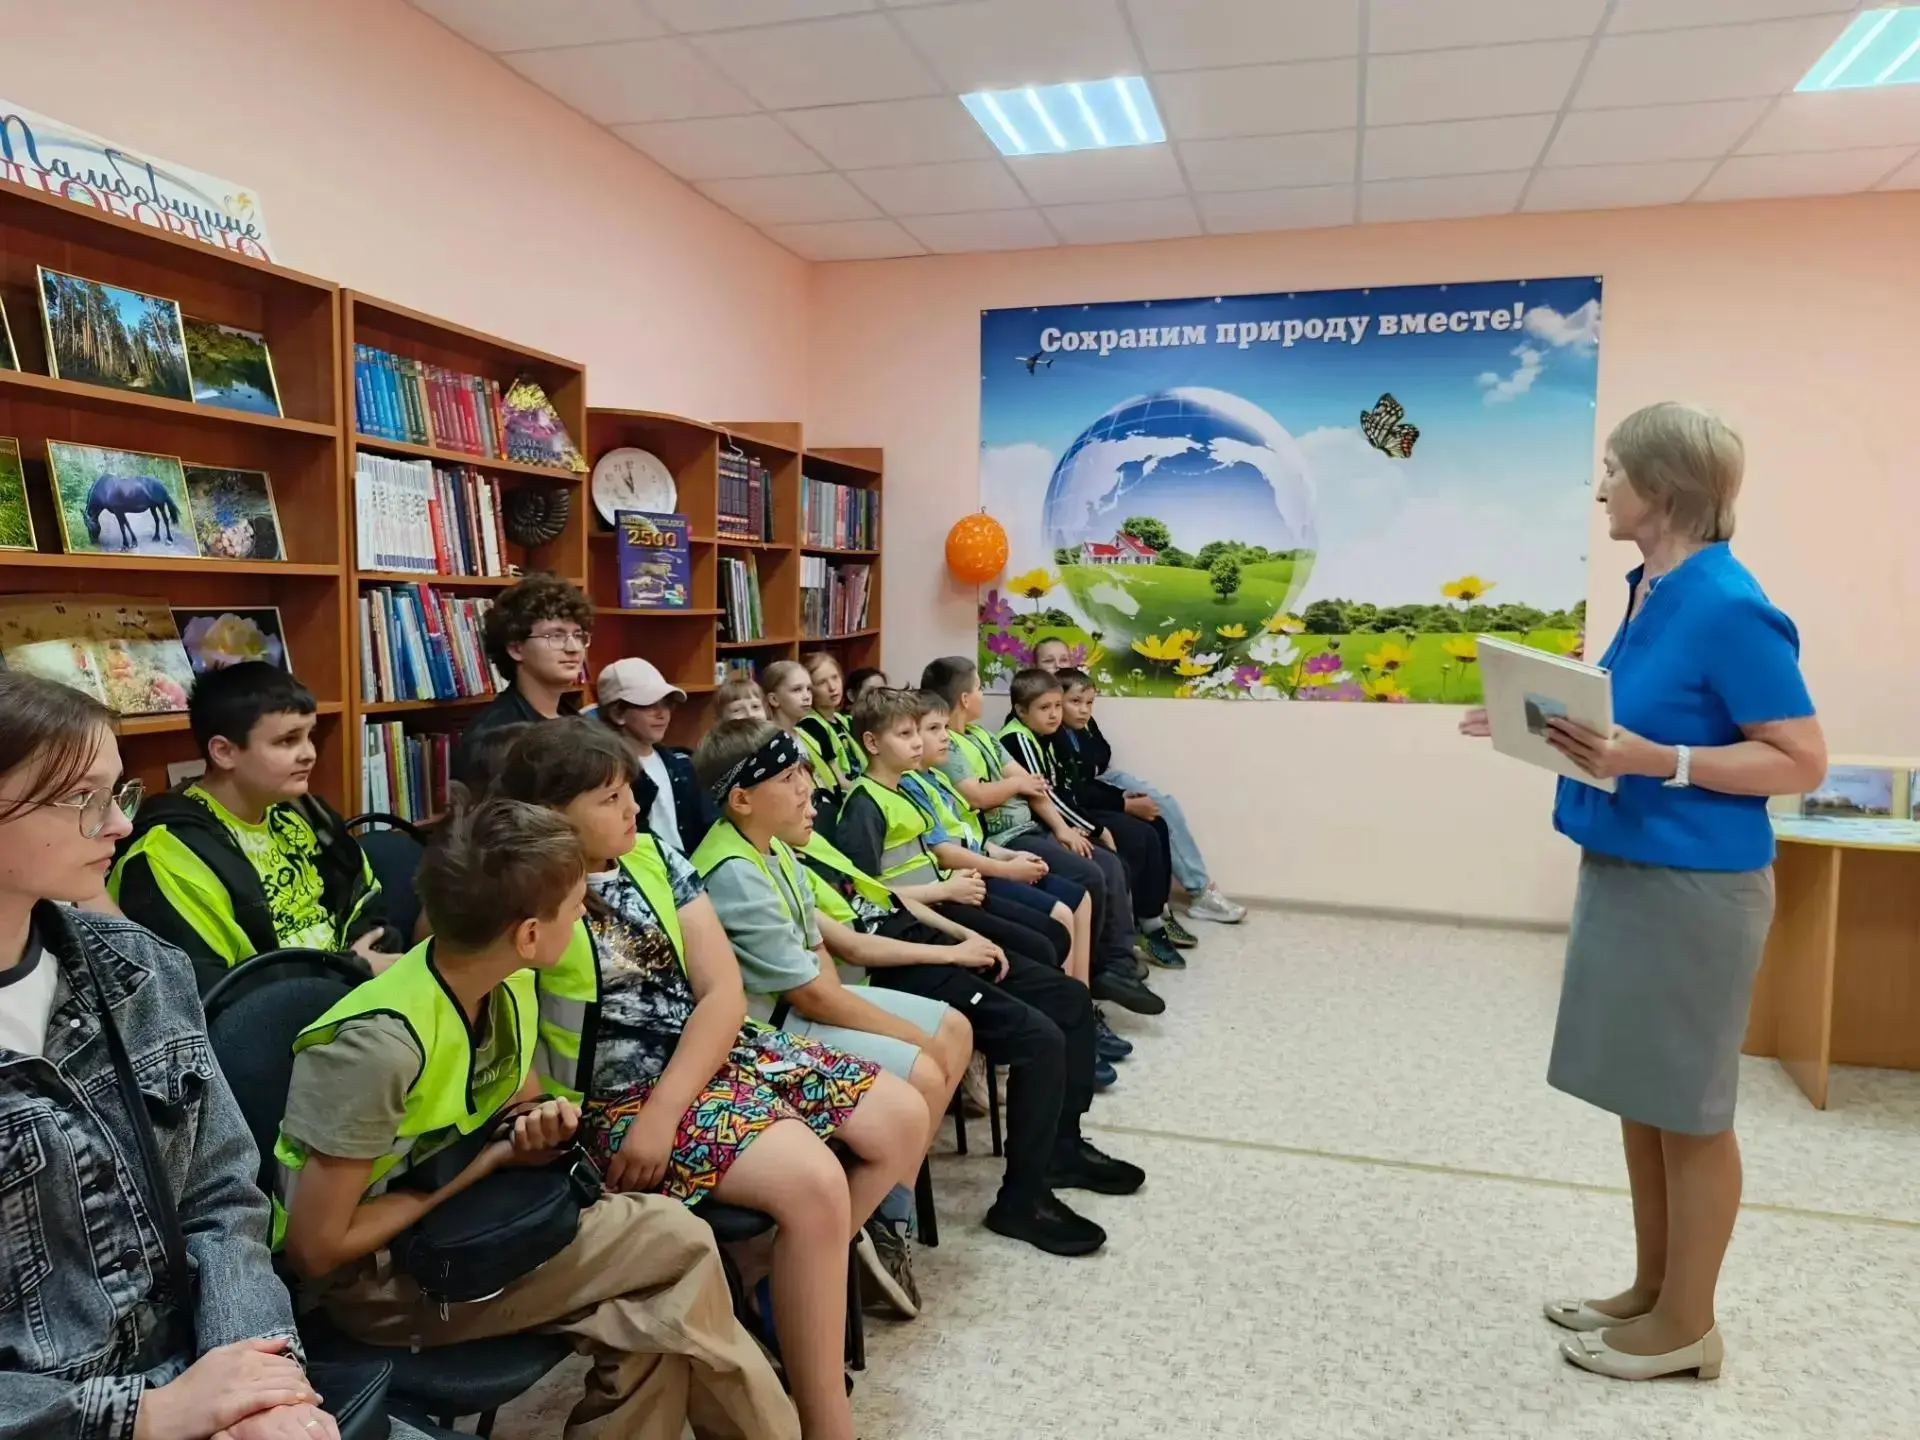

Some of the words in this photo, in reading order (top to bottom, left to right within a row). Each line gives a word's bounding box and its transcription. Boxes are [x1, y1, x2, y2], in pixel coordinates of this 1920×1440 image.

[1040, 323, 1207, 356] Сохраним
[1216, 315, 1370, 350] природу
[1378, 302, 1525, 336] вместе!
[628, 529, 678, 547] 2500
